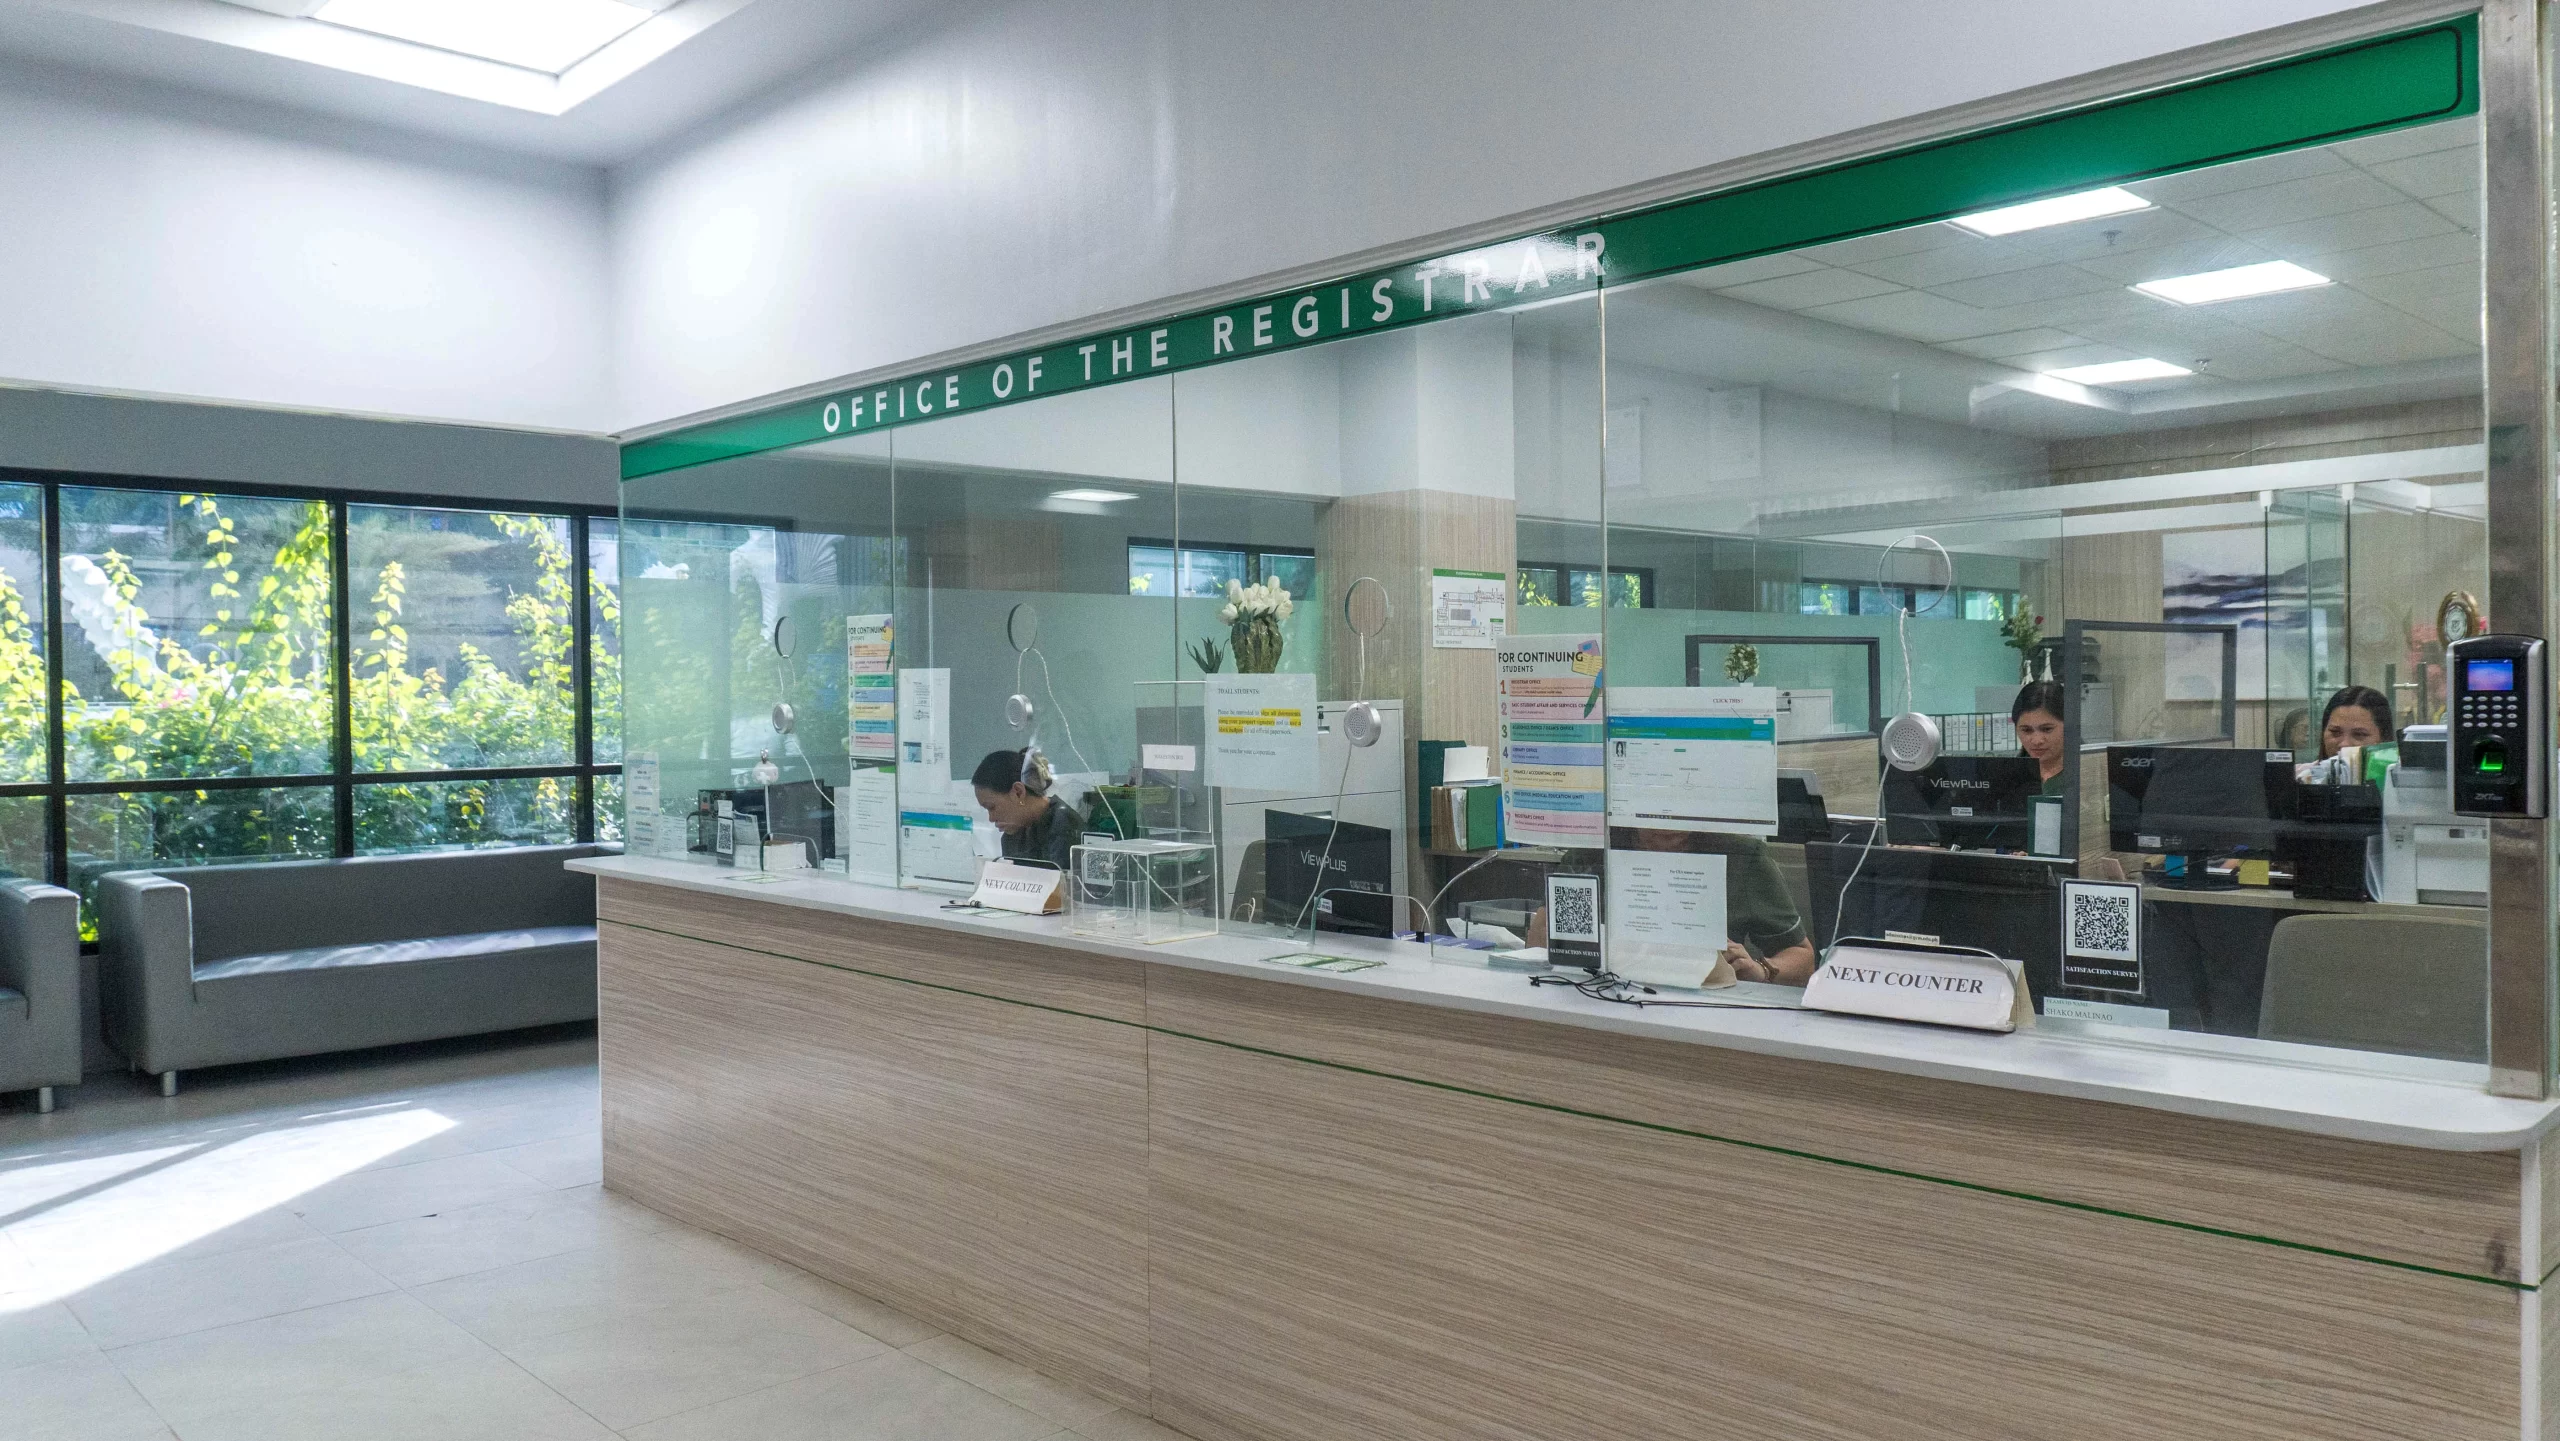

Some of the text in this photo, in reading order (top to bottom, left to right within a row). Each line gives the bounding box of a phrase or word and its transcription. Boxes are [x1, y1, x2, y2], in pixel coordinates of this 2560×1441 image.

[823, 231, 1607, 435] OFFICE OF THE REGISTRAR
[857, 626, 886, 634] CONTINUING
[1498, 651, 1583, 663] FOR CONTINUING
[1502, 665, 1534, 673] STUDENTS
[1500, 680, 1506, 694] 1
[1501, 702, 1507, 716] 2
[1502, 725, 1507, 738] 3
[1503, 747, 1508, 758] 4
[2121, 757, 2155, 767] acer
[1504, 768, 1509, 782] 5
[1505, 790, 1510, 804] 6
[1506, 812, 1510, 825] 7
[984, 878, 1044, 894] NEXT COUNTER
[2066, 966, 2138, 978] SATISFACTION SURVEY
[1826, 965, 1984, 994] NEXT COUNTER
[2046, 1008, 2113, 1021] SHAKO MALINAO
